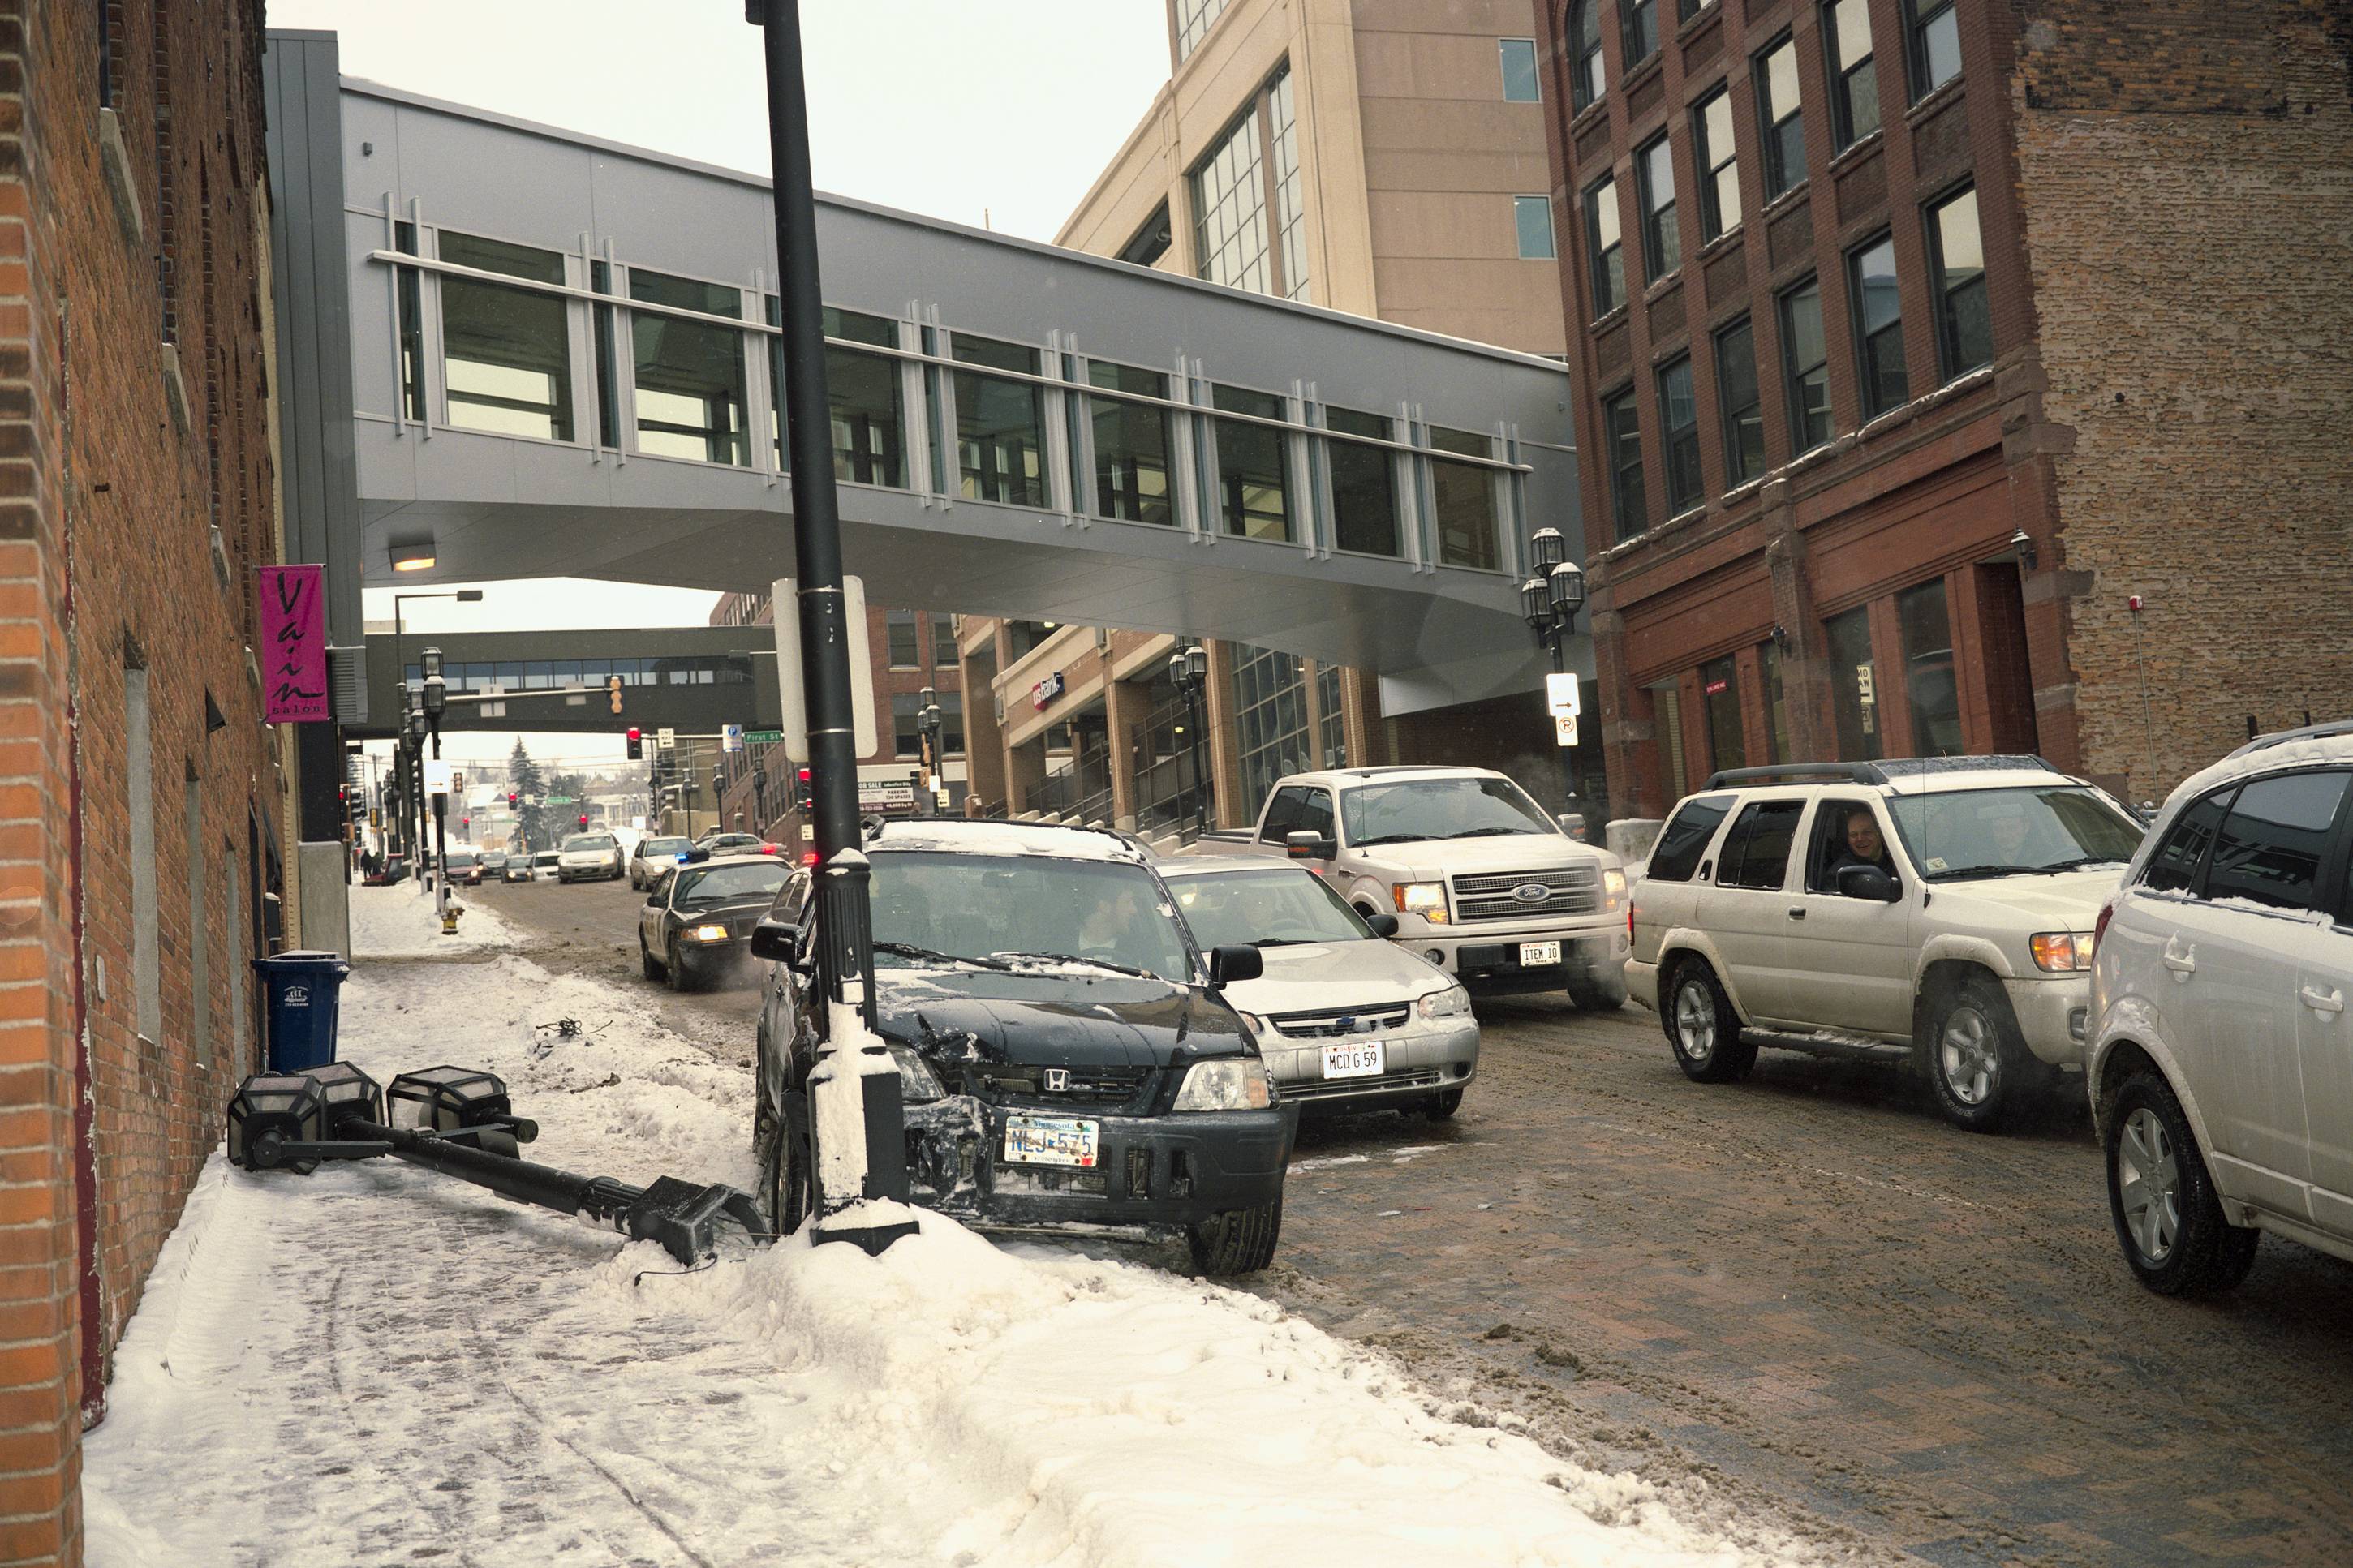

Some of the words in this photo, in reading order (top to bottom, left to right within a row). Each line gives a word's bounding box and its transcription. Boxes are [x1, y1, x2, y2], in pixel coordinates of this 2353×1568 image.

[273, 572, 325, 702] Vain
[273, 704, 320, 715] salon
[746, 733, 766, 741] First
[1524, 888, 1541, 896] Ford
[1525, 948, 1543, 960] ITEM
[1548, 947, 1557, 958] 10
[1329, 1054, 1350, 1070] MCD
[1353, 1052, 1361, 1068] G
[1363, 1051, 1377, 1067] 59
[1057, 1132, 1091, 1156] 575
